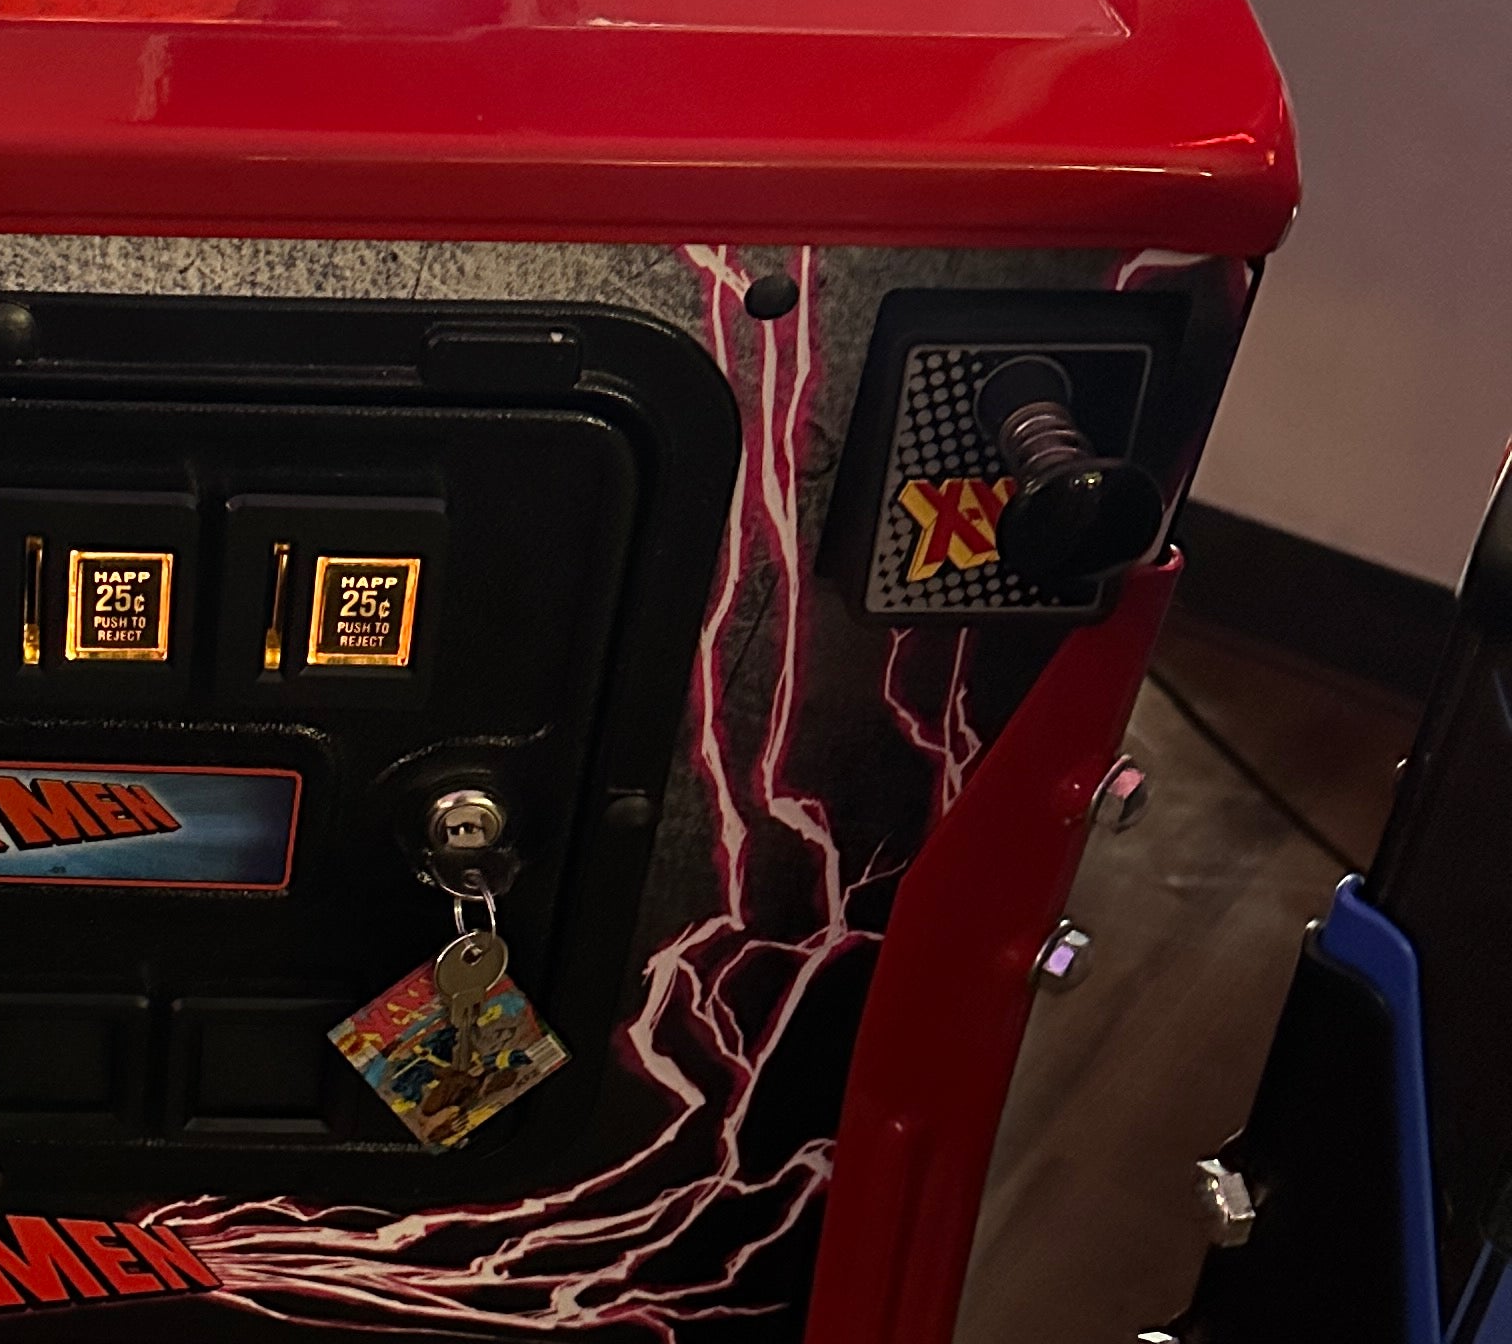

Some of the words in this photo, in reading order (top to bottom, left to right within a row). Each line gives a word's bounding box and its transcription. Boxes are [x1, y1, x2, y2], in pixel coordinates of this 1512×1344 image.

[94, 571, 151, 583] HAPP
[341, 576, 398, 589] HAPP
[95, 584, 146, 614] 25¢
[339, 589, 391, 620] 25¢
[93, 615, 128, 628] PUSH
[132, 616, 147, 629] TO
[337, 621, 371, 634] PUSH
[375, 622, 390, 634] TO
[97, 630, 143, 641] REJECT
[339, 635, 385, 647] REJECT
